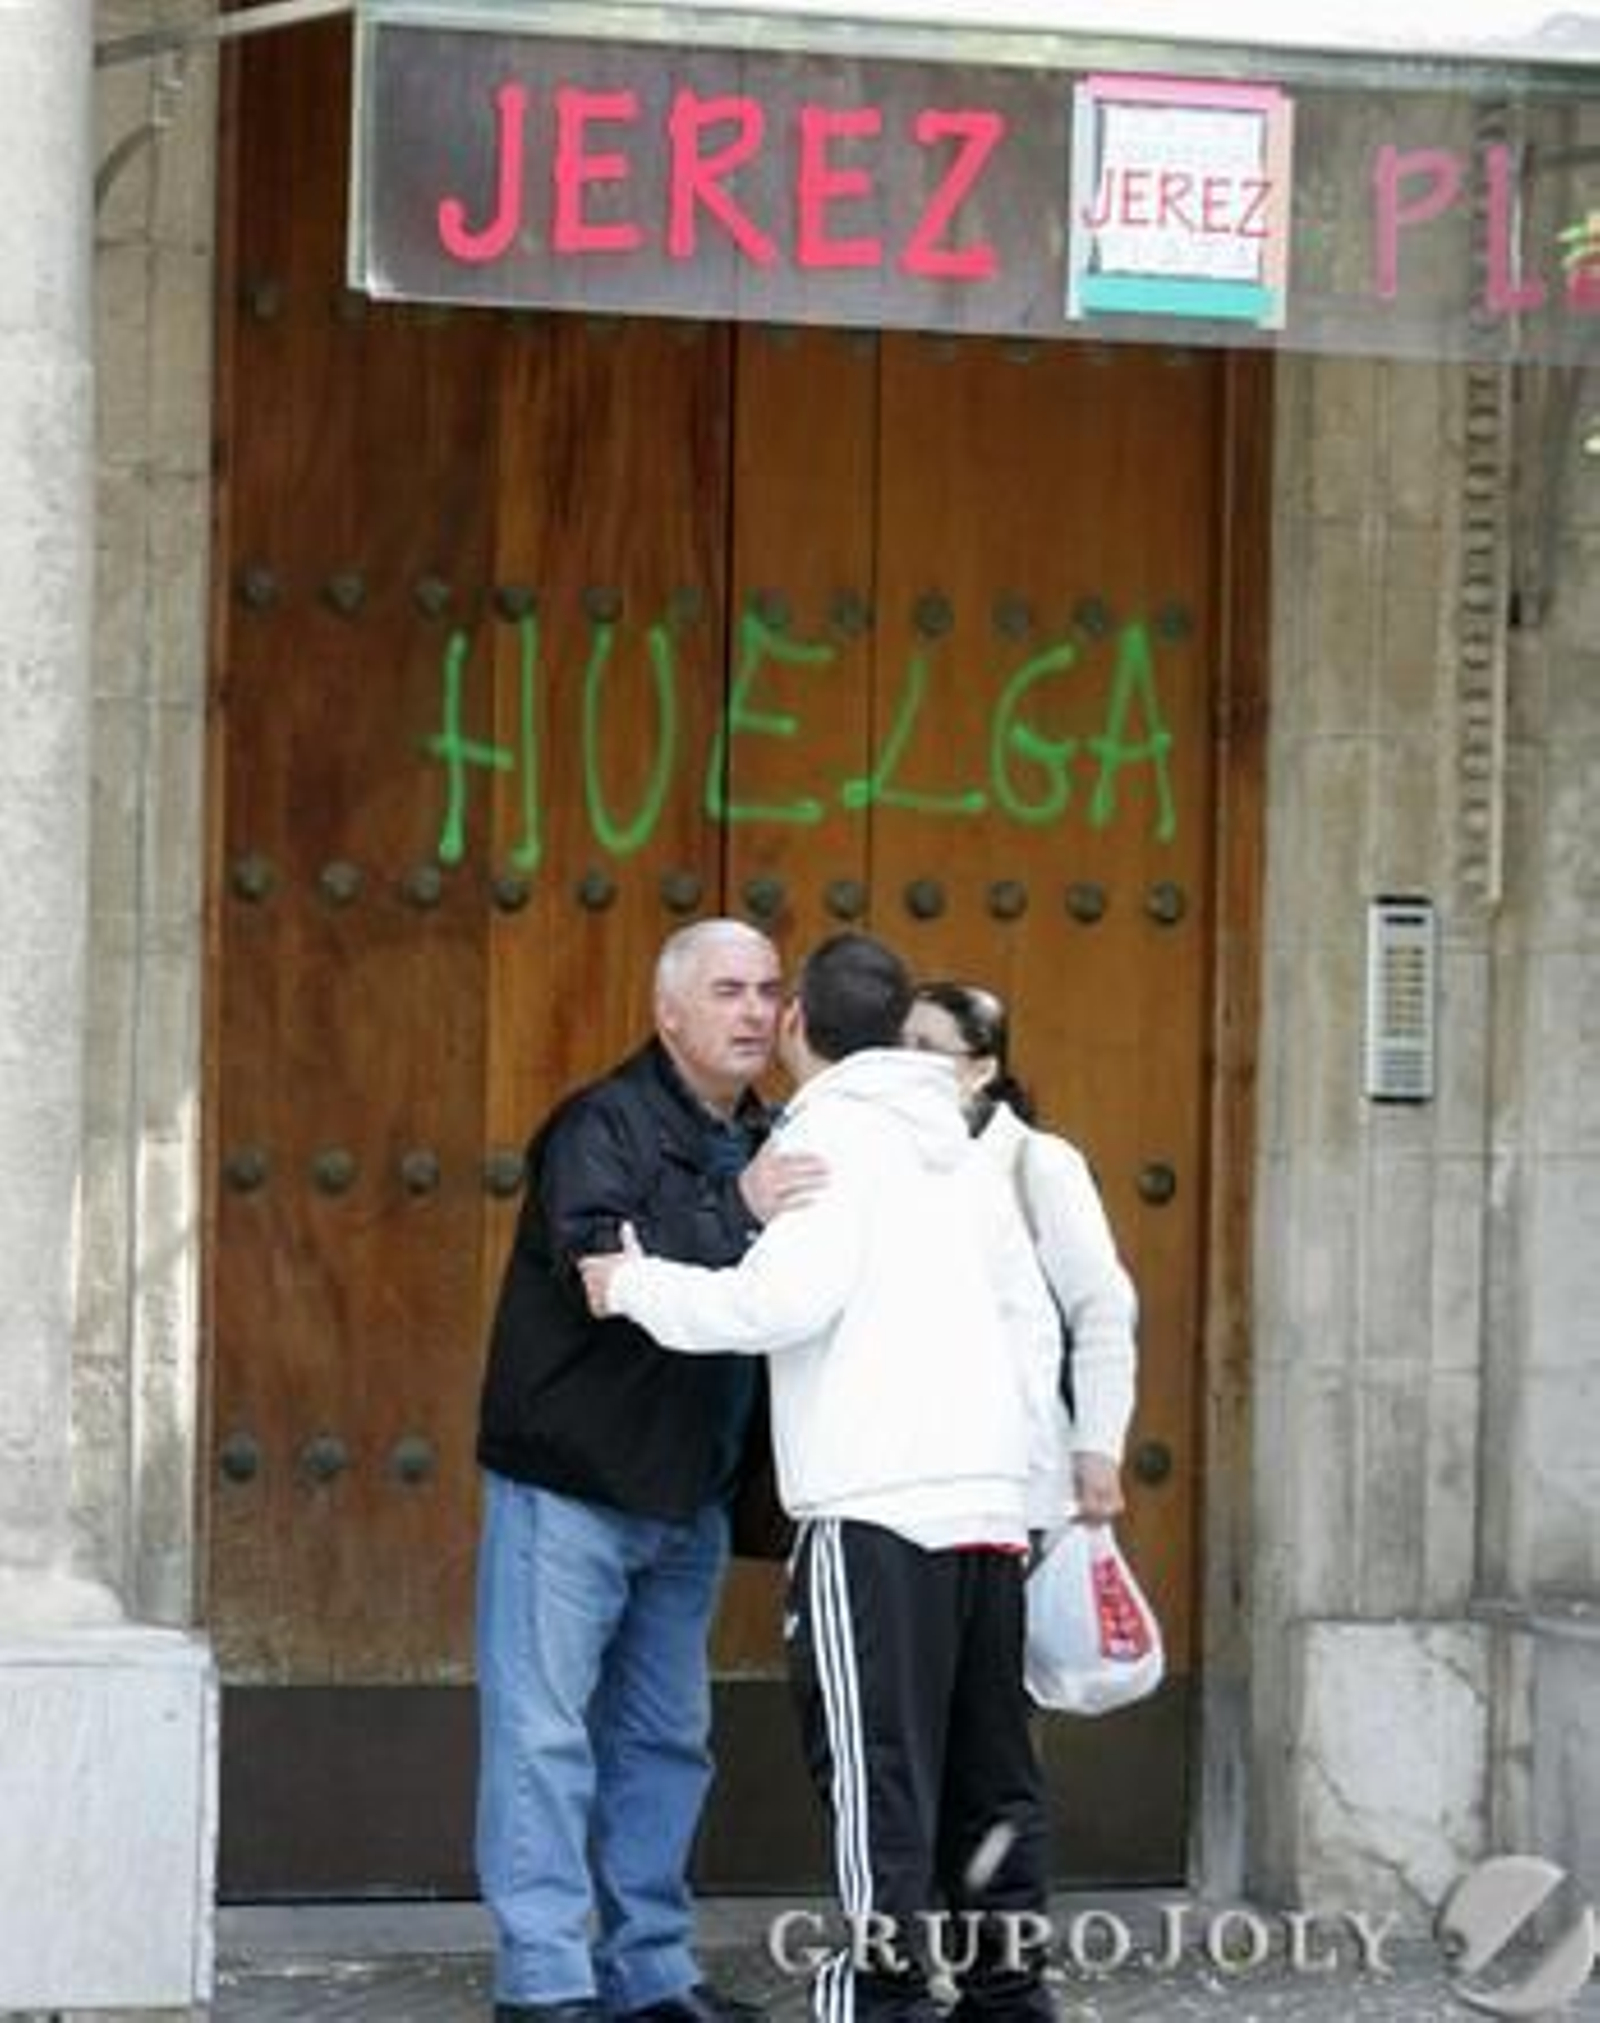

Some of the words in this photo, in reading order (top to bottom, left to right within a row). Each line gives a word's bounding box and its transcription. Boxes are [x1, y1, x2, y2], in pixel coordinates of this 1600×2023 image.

[437, 82, 1006, 279] JEREZ
[1373, 143, 1600, 315] PL
[1082, 168, 1273, 238] JEREZ
[430, 612, 1177, 870] HUELGA
